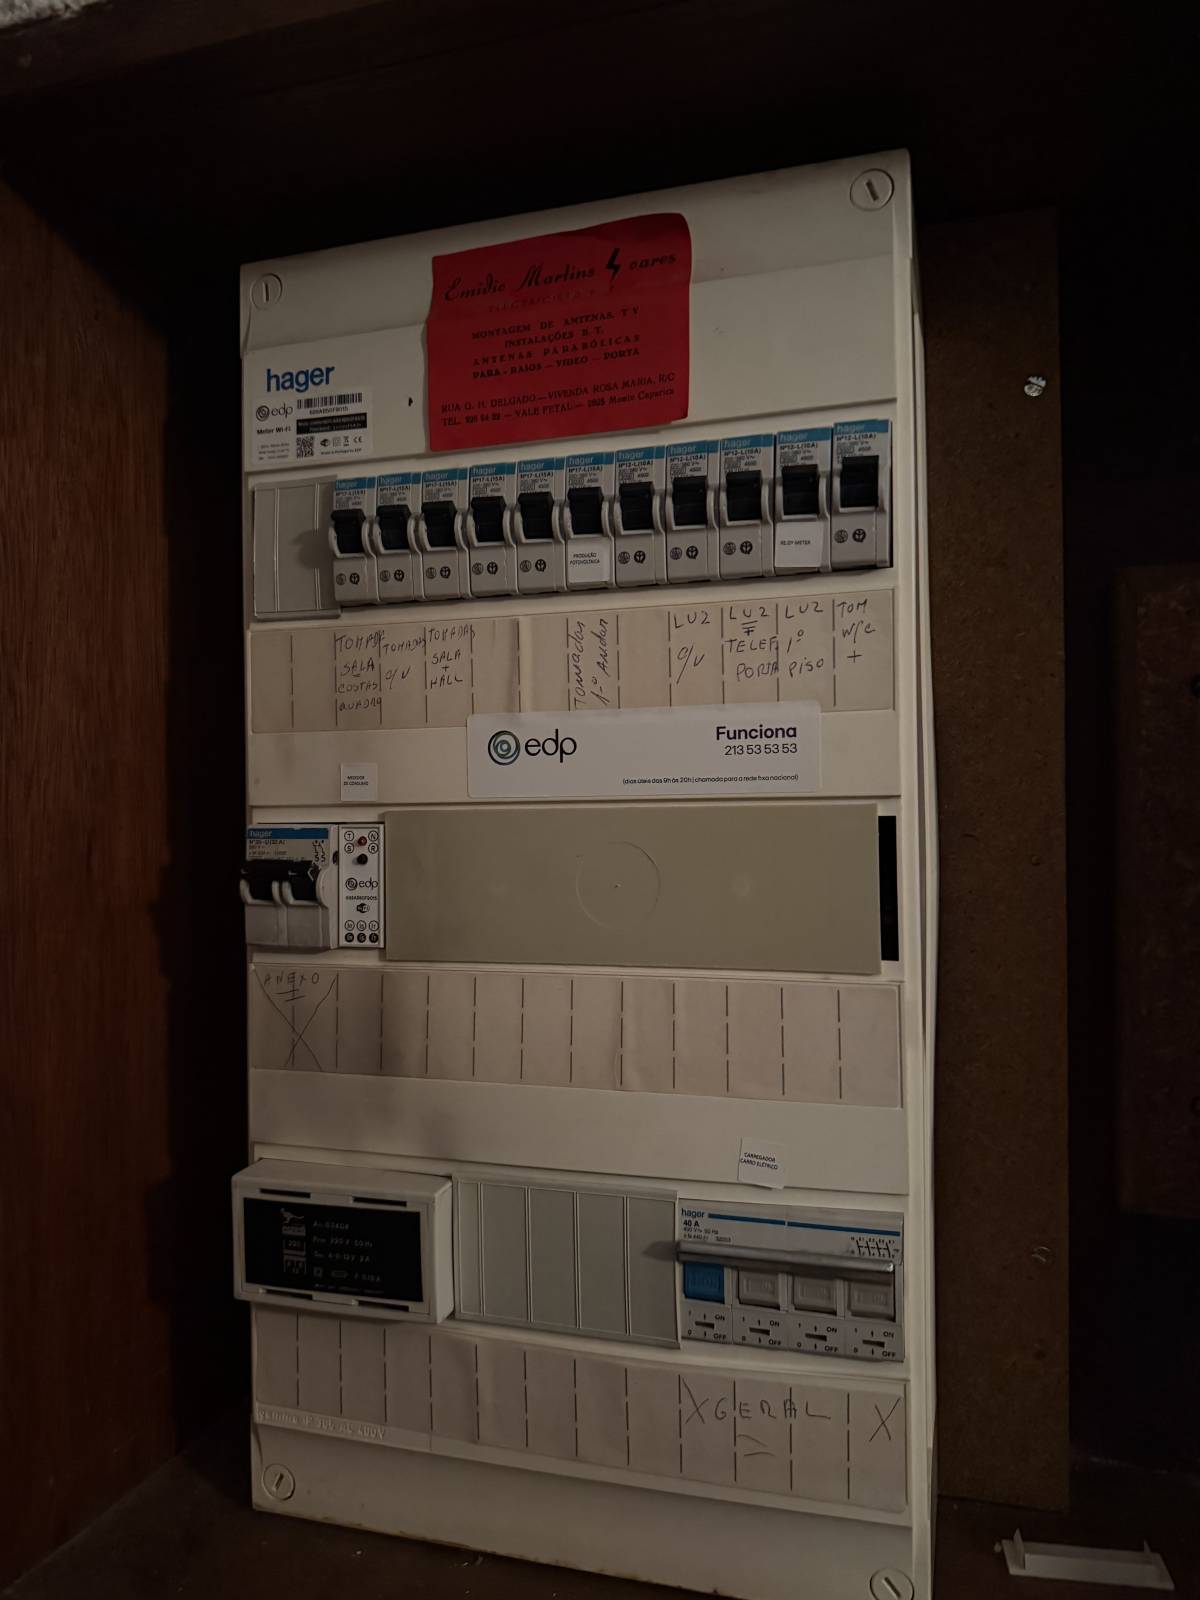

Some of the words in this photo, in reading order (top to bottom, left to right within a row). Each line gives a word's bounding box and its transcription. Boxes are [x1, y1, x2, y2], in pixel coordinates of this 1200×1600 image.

[515, 261, 595, 293] Martins
[471, 324, 531, 339] MONTAGEM
[540, 320, 553, 330] DE
[564, 311, 612, 326] ANTENAS
[504, 330, 574, 349] INSTALAÇÕES
[473, 352, 533, 366] ANTENAS
[543, 334, 641, 357] PARABÓLICAS
[555, 356, 588, 368] VIDEO
[603, 348, 640, 361] PORTA
[266, 366, 335, 393] hager
[441, 403, 461, 414] RUA
[490, 394, 537, 408] DELGADO
[548, 386, 588, 400] VIVENDA
[592, 381, 618, 392] ROSA
[515, 406, 540, 418] VALE
[637, 388, 675, 402] Caparica
[271, 403, 294, 419] edp
[618, 451, 645, 461] hager
[670, 446, 697, 455] hager
[520, 462, 545, 470] hager
[569, 456, 594, 465] hager
[472, 466, 496, 475] hager
[431, 649, 461, 664] SALA
[430, 674, 463, 689] HALL
[715, 724, 798, 741] Funciona
[524, 728, 578, 764] edp
[724, 744, 746, 757] 213
[746, 743, 763, 756] 53
[765, 743, 781, 756] 53
[781, 743, 798, 755] 53
[723, 776, 738, 784] para
[358, 877, 378, 891] edp
[744, 1152, 776, 1163] CARREGADOR
[740, 1158, 756, 1166] CARRO
[757, 1161, 778, 1170] ELÉTRICO
[681, 1208, 705, 1218] hager
[715, 1314, 725, 1322] ON
[769, 1320, 780, 1328] ON
[713, 1332, 727, 1340] OFF
[826, 1326, 838, 1334] ON
[883, 1330, 894, 1338] ON
[768, 1338, 782, 1346] OFF
[824, 1345, 839, 1353] OFF
[882, 1350, 896, 1358] OFF
[714, 1397, 831, 1421] GERAL
